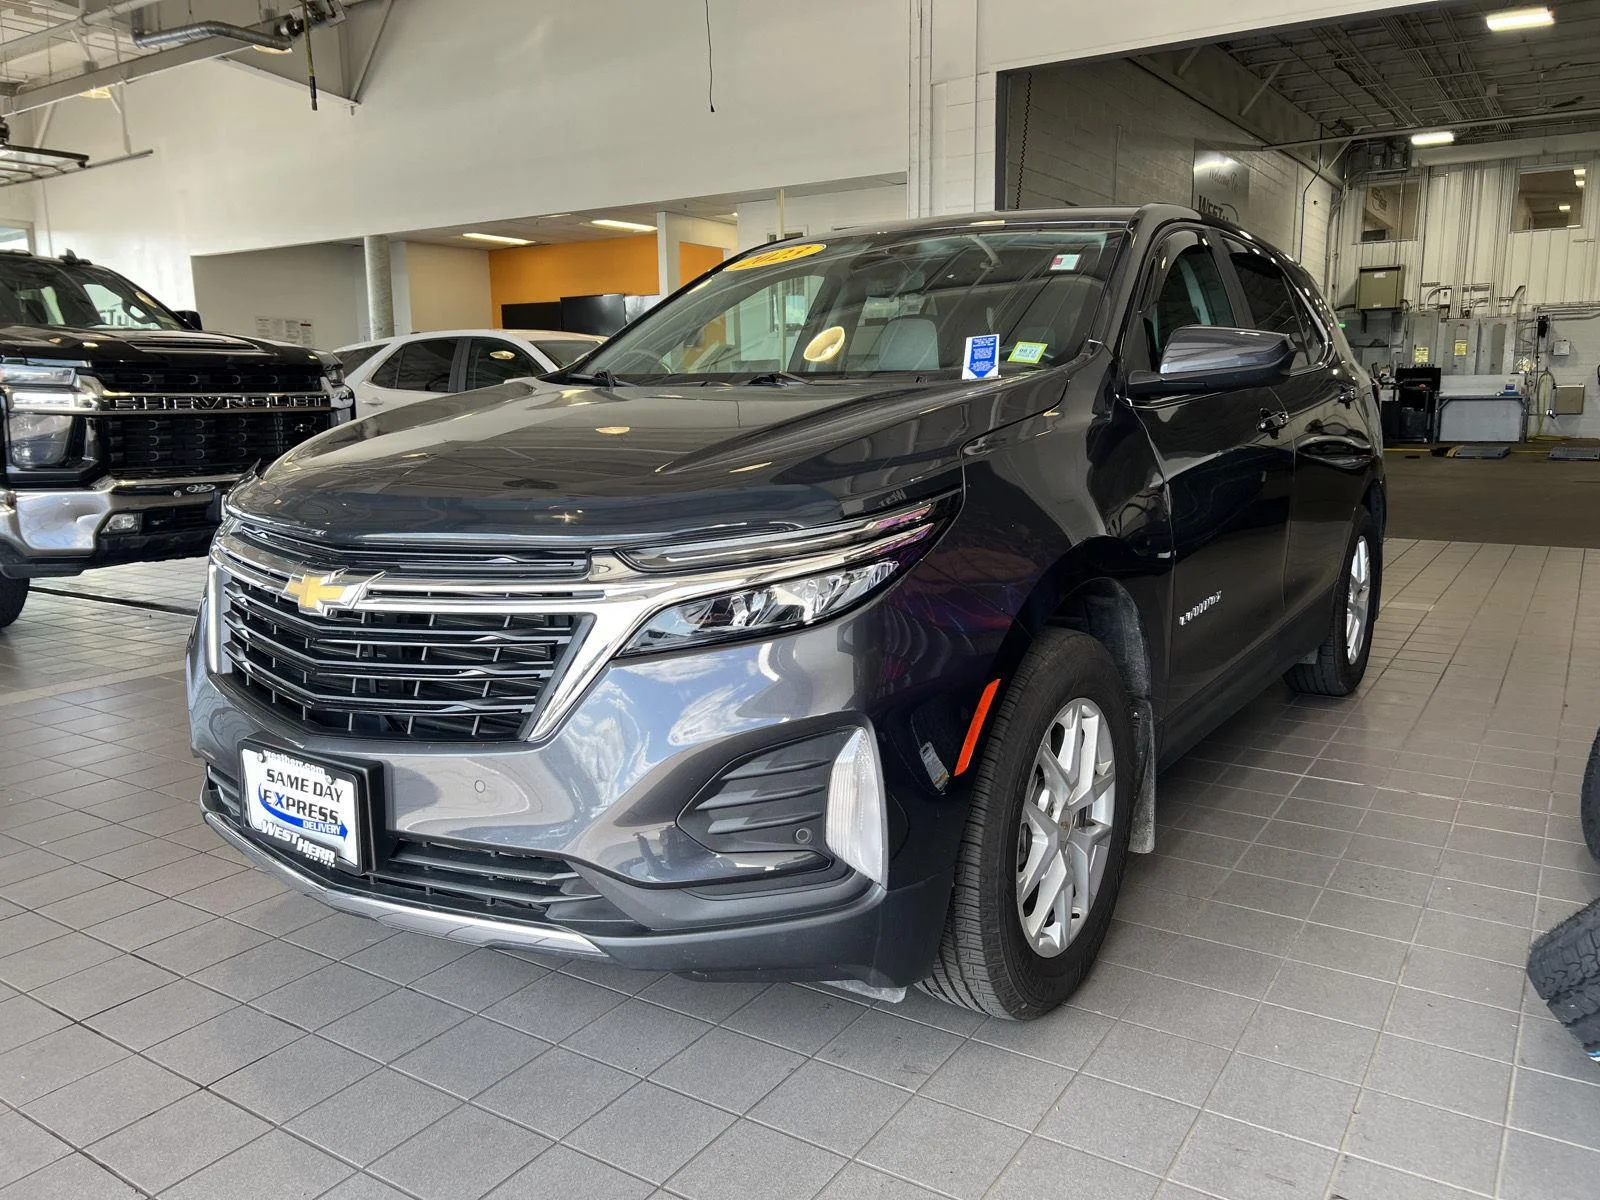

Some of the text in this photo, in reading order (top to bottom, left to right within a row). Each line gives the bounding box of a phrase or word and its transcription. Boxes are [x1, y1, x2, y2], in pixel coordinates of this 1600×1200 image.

[112, 395, 328, 411] CHEVROLET
[266, 768, 343, 803] SAME DAY
[263, 789, 339, 824] EXPRESS
[260, 819, 336, 863] WEST HERR
[302, 820, 341, 835] DELIVERY
